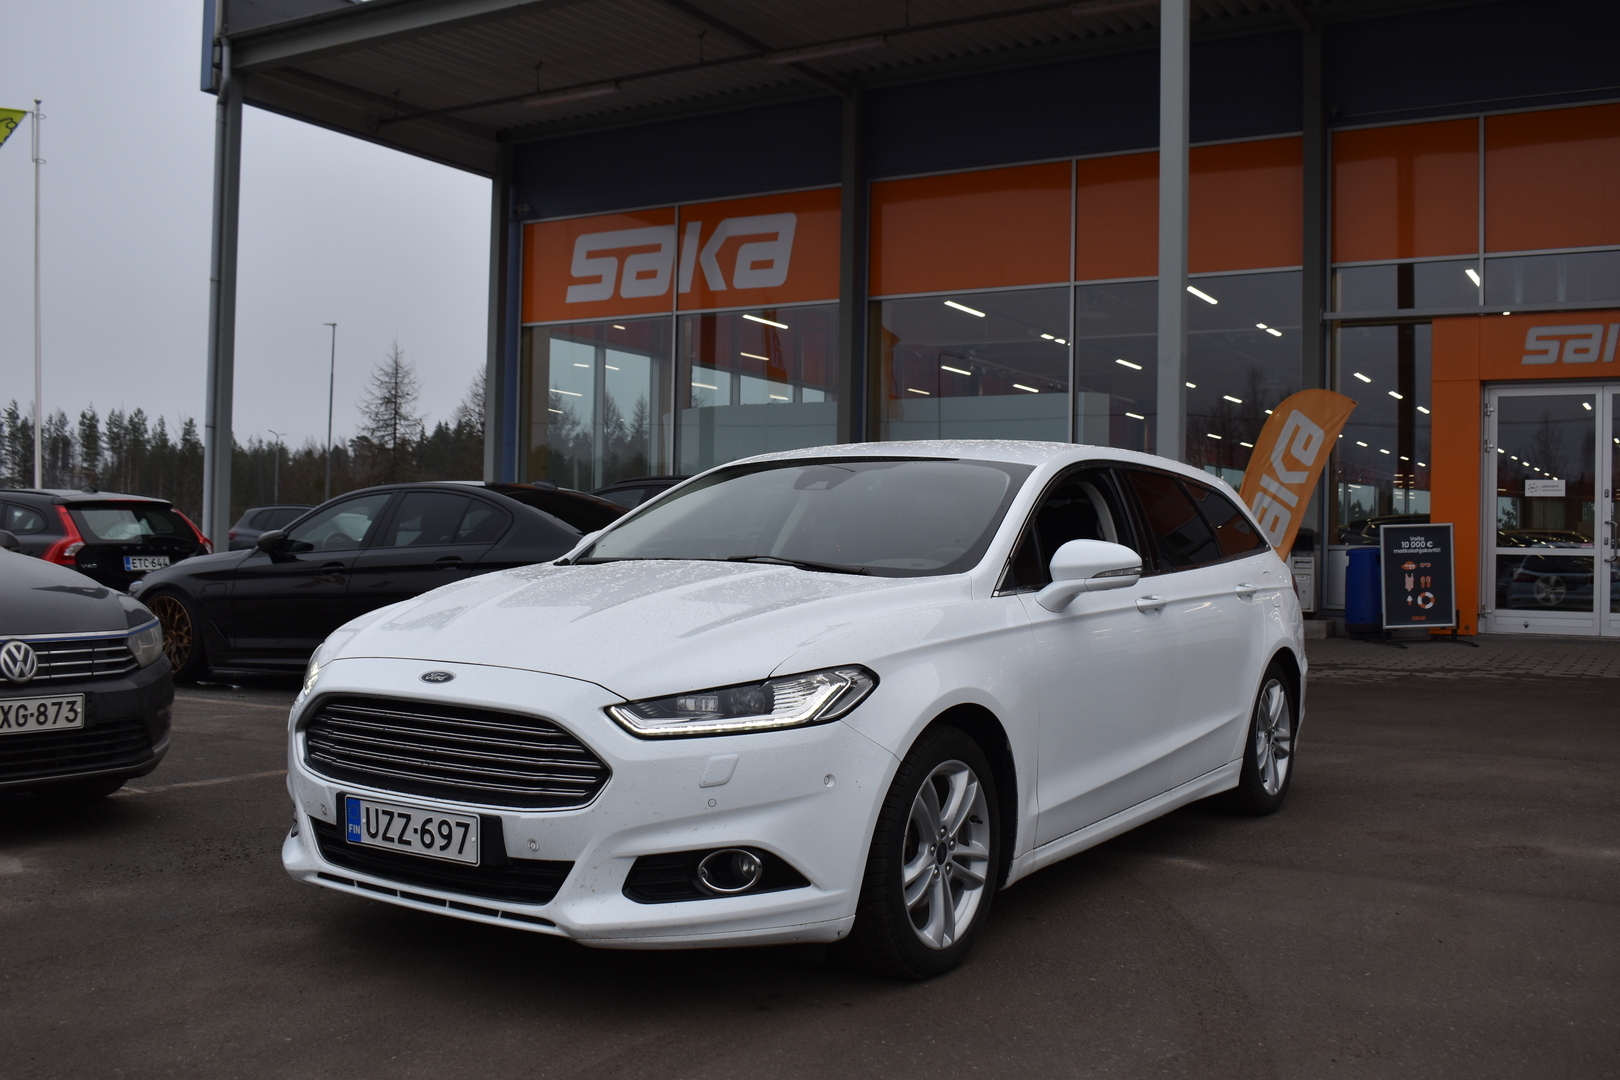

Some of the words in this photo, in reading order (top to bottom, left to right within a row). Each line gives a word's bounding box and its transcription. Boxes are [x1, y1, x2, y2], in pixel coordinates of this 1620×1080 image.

[131, 558, 168, 569] ETC-644
[0, 701, 78, 728] XG-873
[348, 823, 361, 835] FIN
[365, 806, 471, 855] UZZ-697
